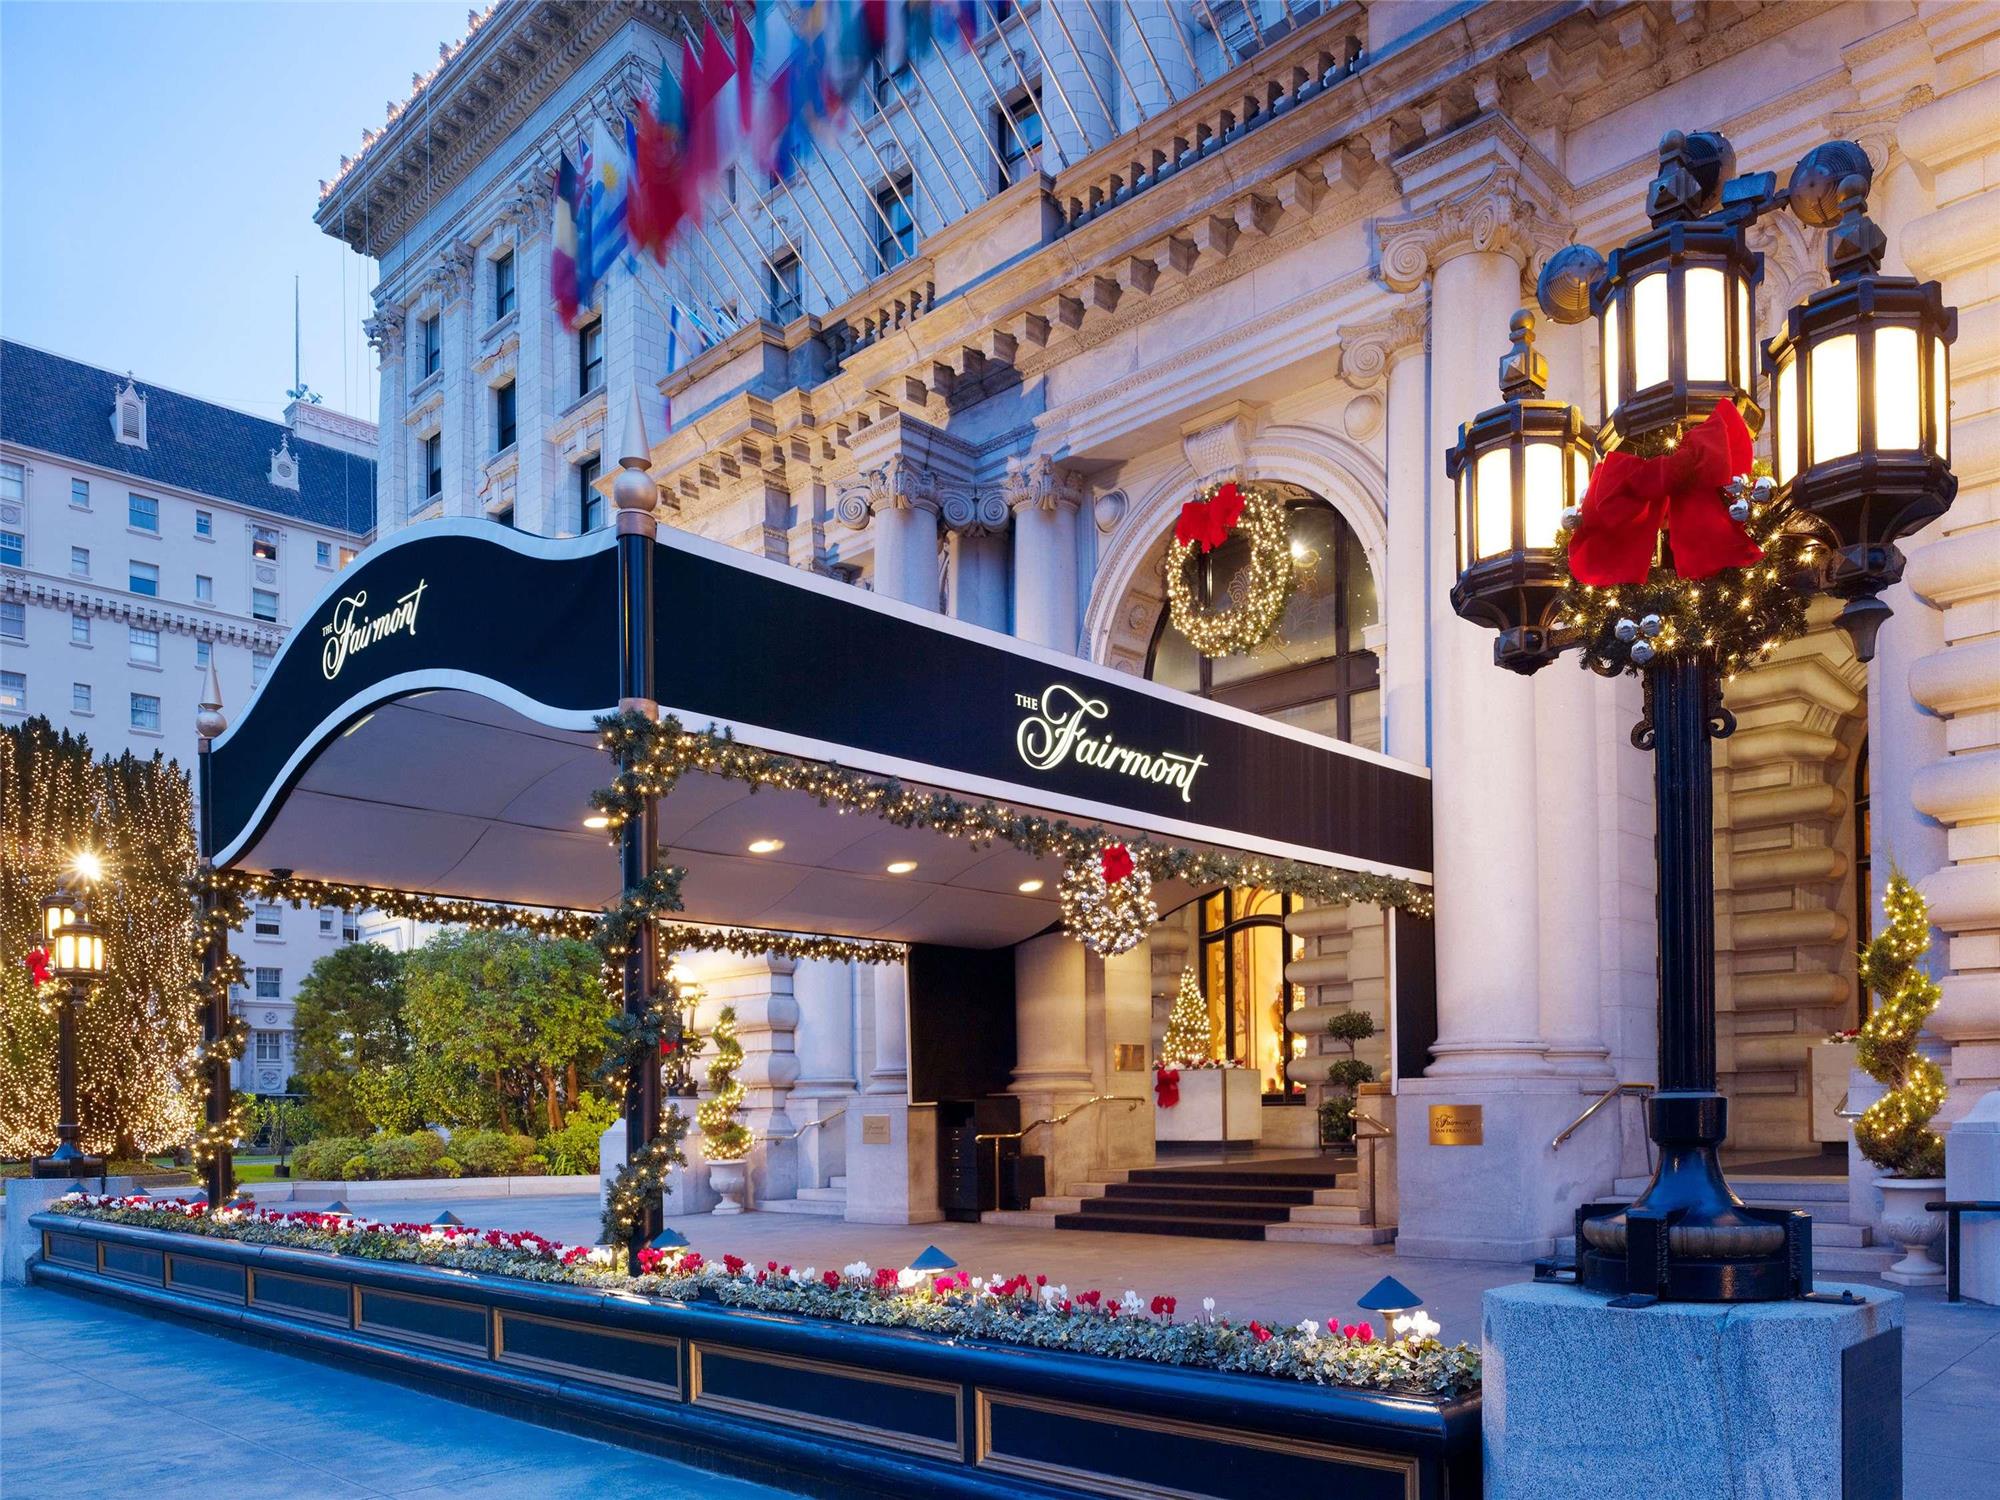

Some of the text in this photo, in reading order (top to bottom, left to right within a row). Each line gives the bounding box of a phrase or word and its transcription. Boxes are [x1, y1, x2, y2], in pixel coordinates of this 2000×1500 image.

[322, 578, 428, 680] THE Fairmont
[1014, 684, 1209, 803] THE Fairmont
